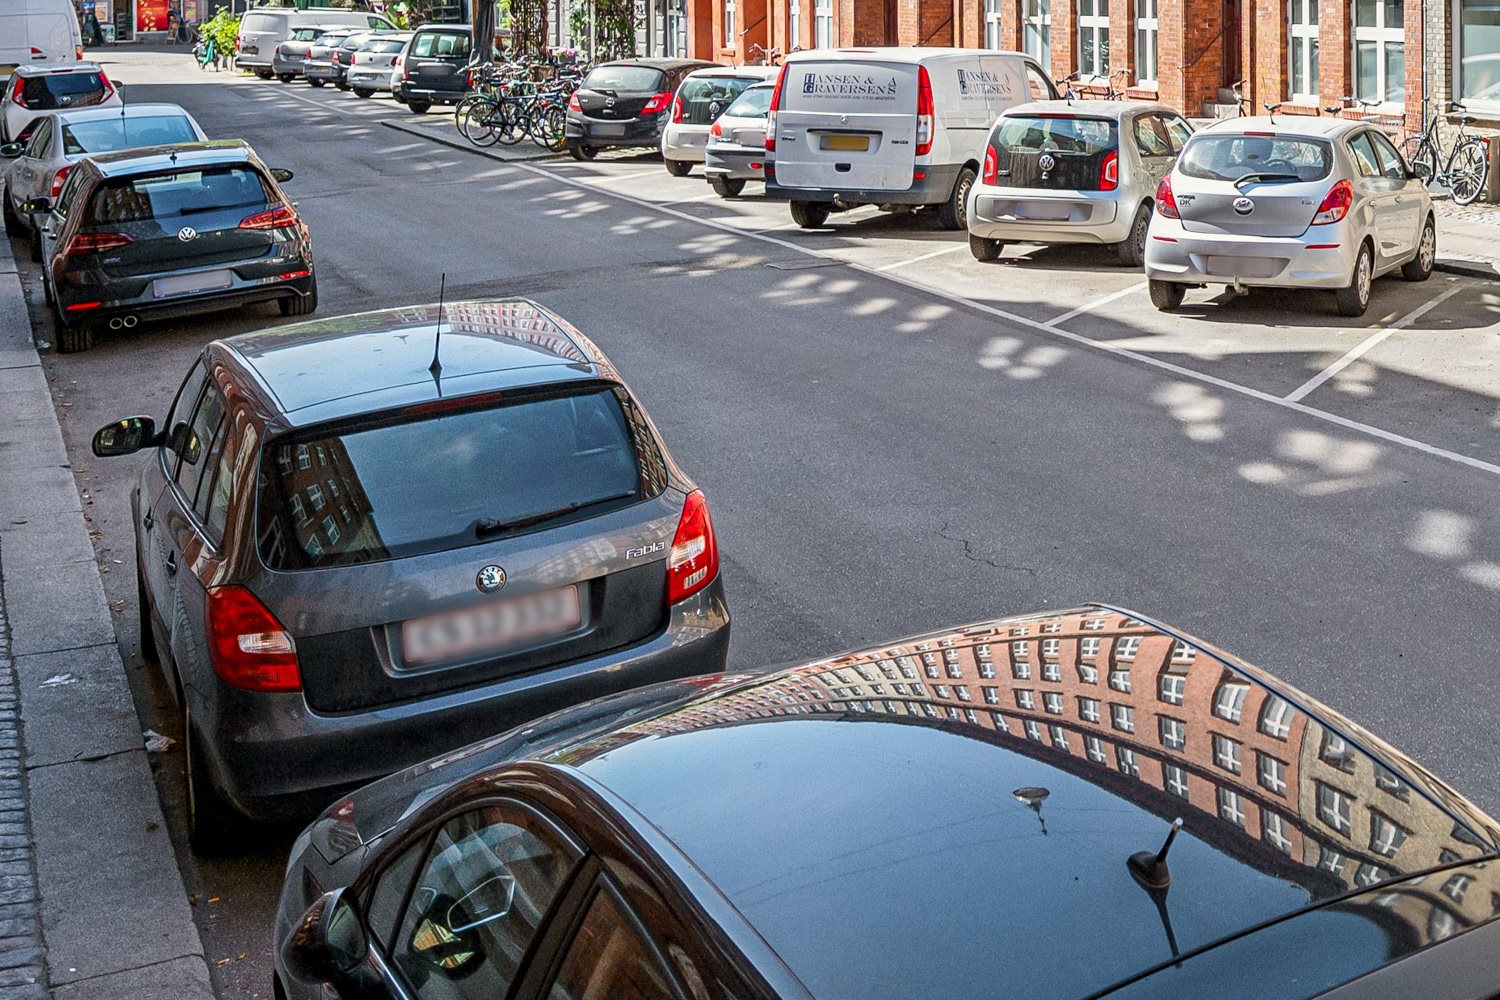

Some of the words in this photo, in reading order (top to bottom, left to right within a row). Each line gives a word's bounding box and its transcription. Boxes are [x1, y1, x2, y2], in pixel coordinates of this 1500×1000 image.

[804, 73, 860, 84] HANSEN
[864, 76, 874, 85] &
[1180, 199, 1192, 207] DK
